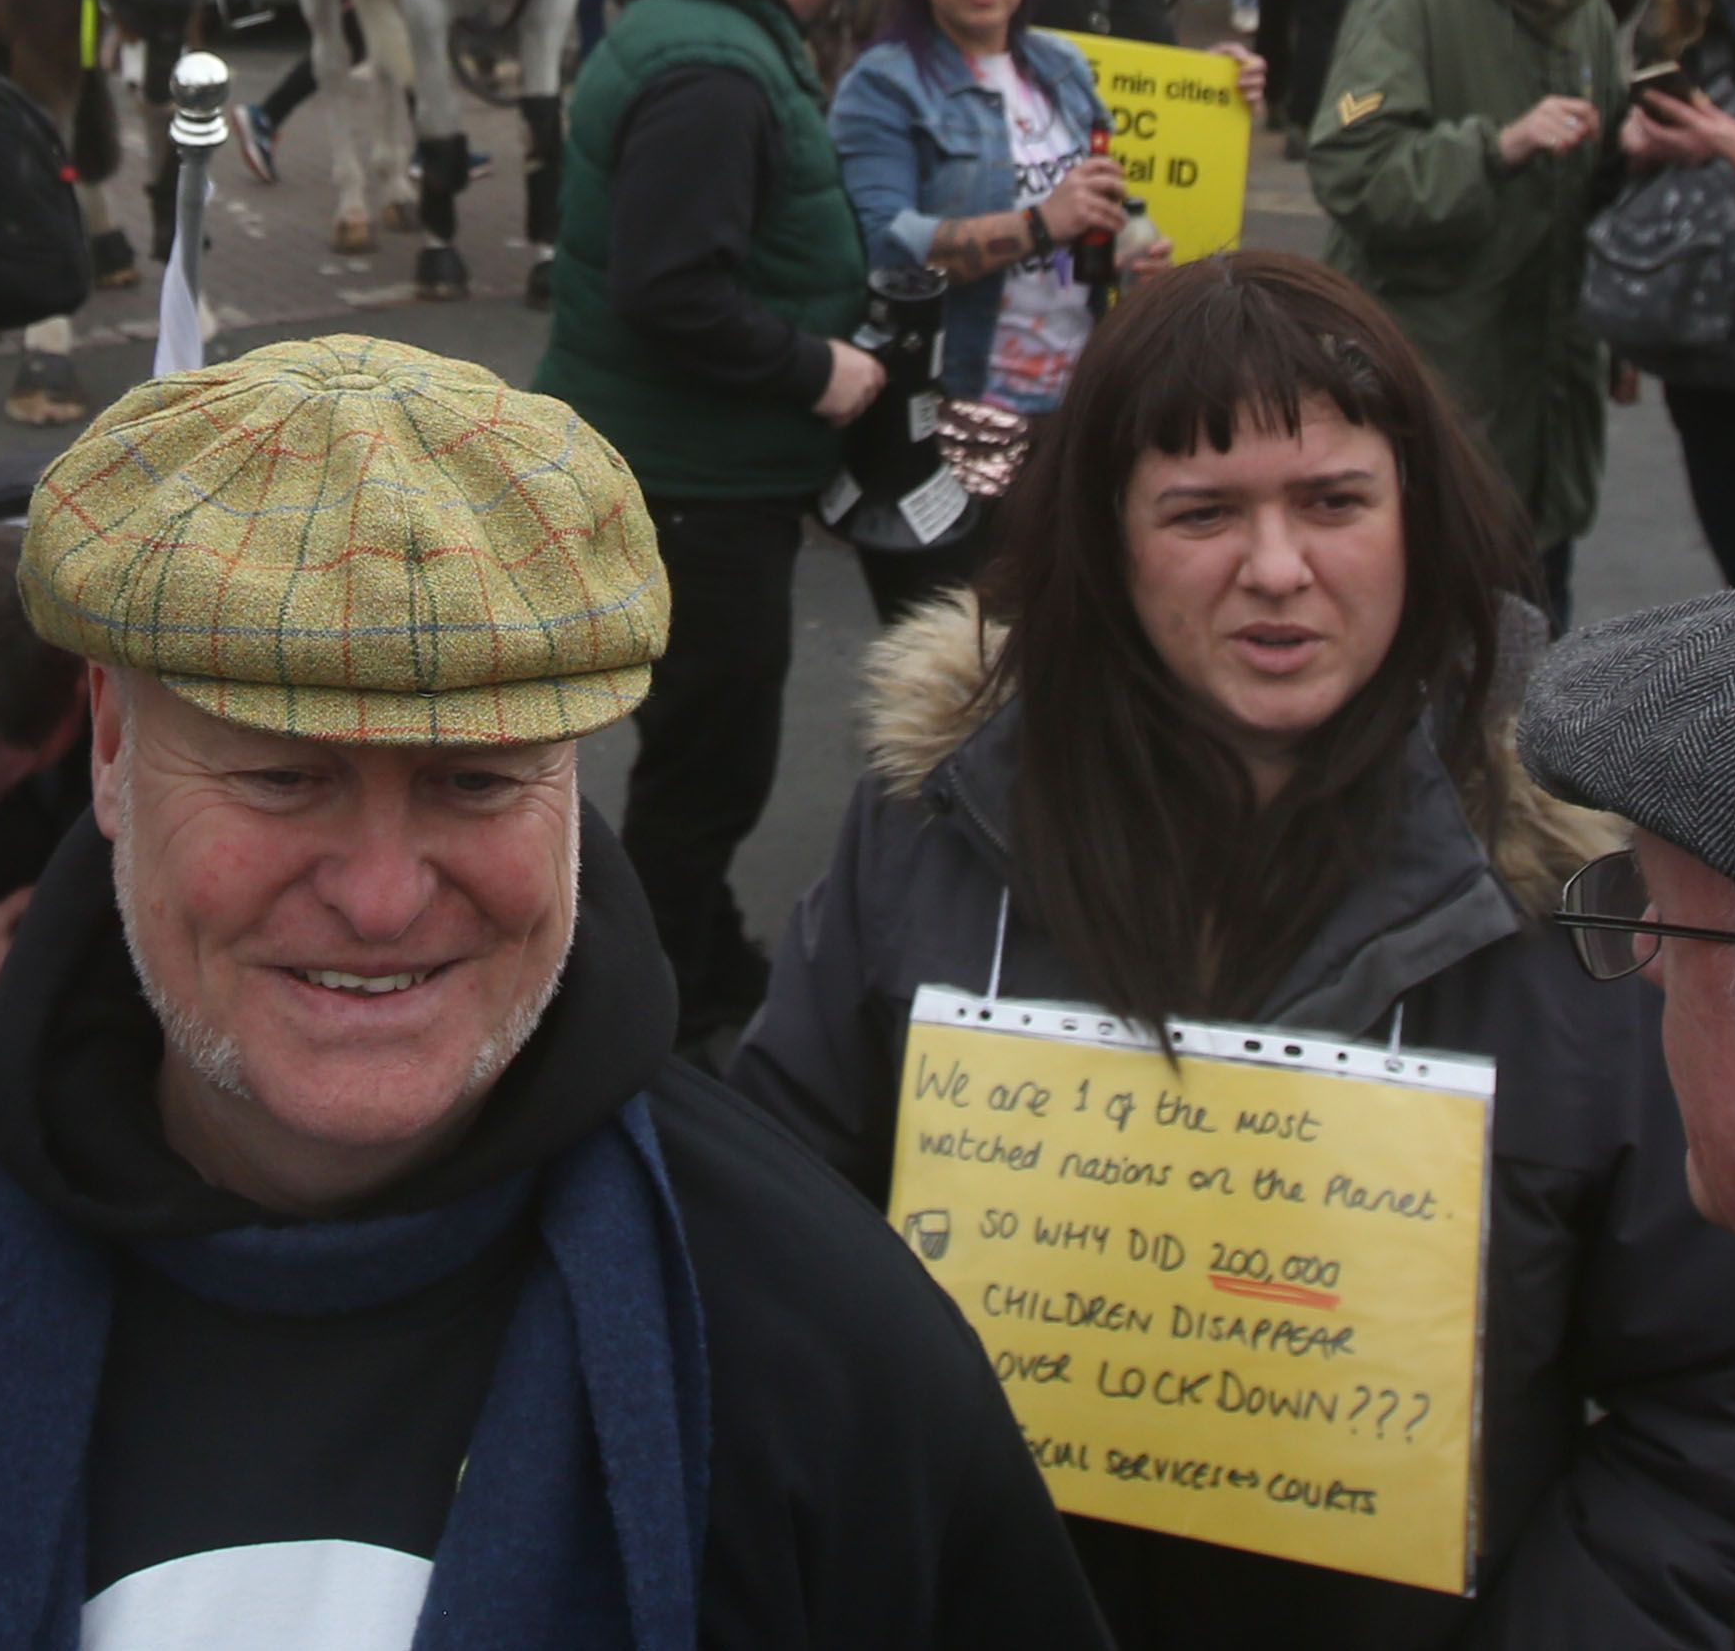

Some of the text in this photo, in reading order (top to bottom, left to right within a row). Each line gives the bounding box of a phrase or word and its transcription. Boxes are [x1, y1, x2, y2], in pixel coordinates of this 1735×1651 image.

[1111, 71, 1155, 95] min
[1166, 77, 1231, 105] cities
[1114, 152, 1154, 182] tal
[1168, 159, 1199, 188] ID
[916, 1053, 969, 1107] We
[988, 1081, 1051, 1117] are
[1074, 1078, 1090, 1111] 1
[1106, 1091, 1136, 1132] of
[1155, 1090, 1217, 1133] the
[919, 1128, 1042, 1171] watched
[1058, 1152, 1172, 1187] nations
[1188, 1166, 1234, 1195] on
[1253, 1168, 1306, 1203] the
[979, 1207, 1341, 1290] SO WHY DID 200,000
[983, 1283, 1356, 1360] CHILDREN DISAPPEAR
[993, 1350, 1071, 1386] OVER
[1105, 1450, 1221, 1490] SERVICES
[1266, 1473, 1377, 1515] COURTS
